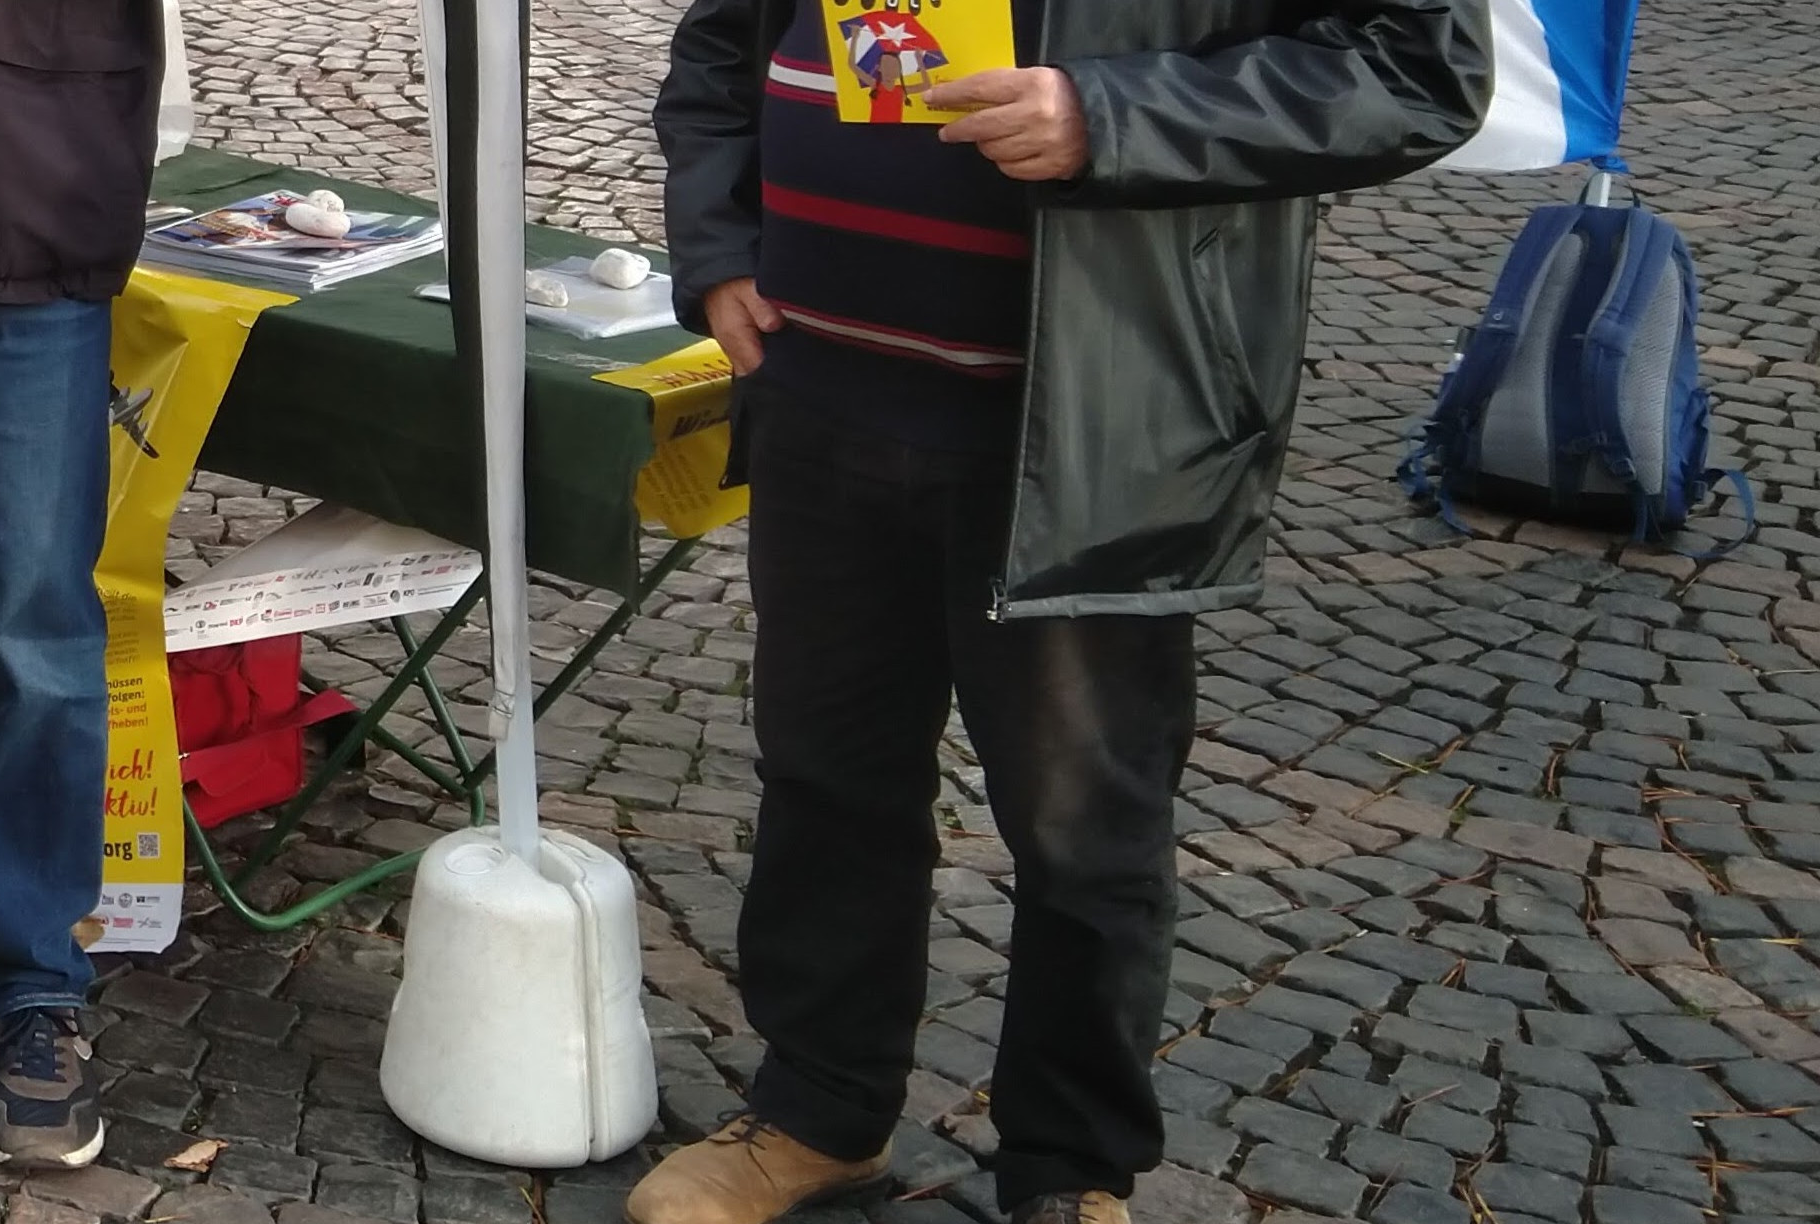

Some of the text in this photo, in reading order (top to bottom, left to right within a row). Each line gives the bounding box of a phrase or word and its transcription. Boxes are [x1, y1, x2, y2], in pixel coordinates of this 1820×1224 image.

[126, 703, 147, 714] und
[109, 748, 153, 780] ich!
[105, 787, 158, 818] ktiv!
